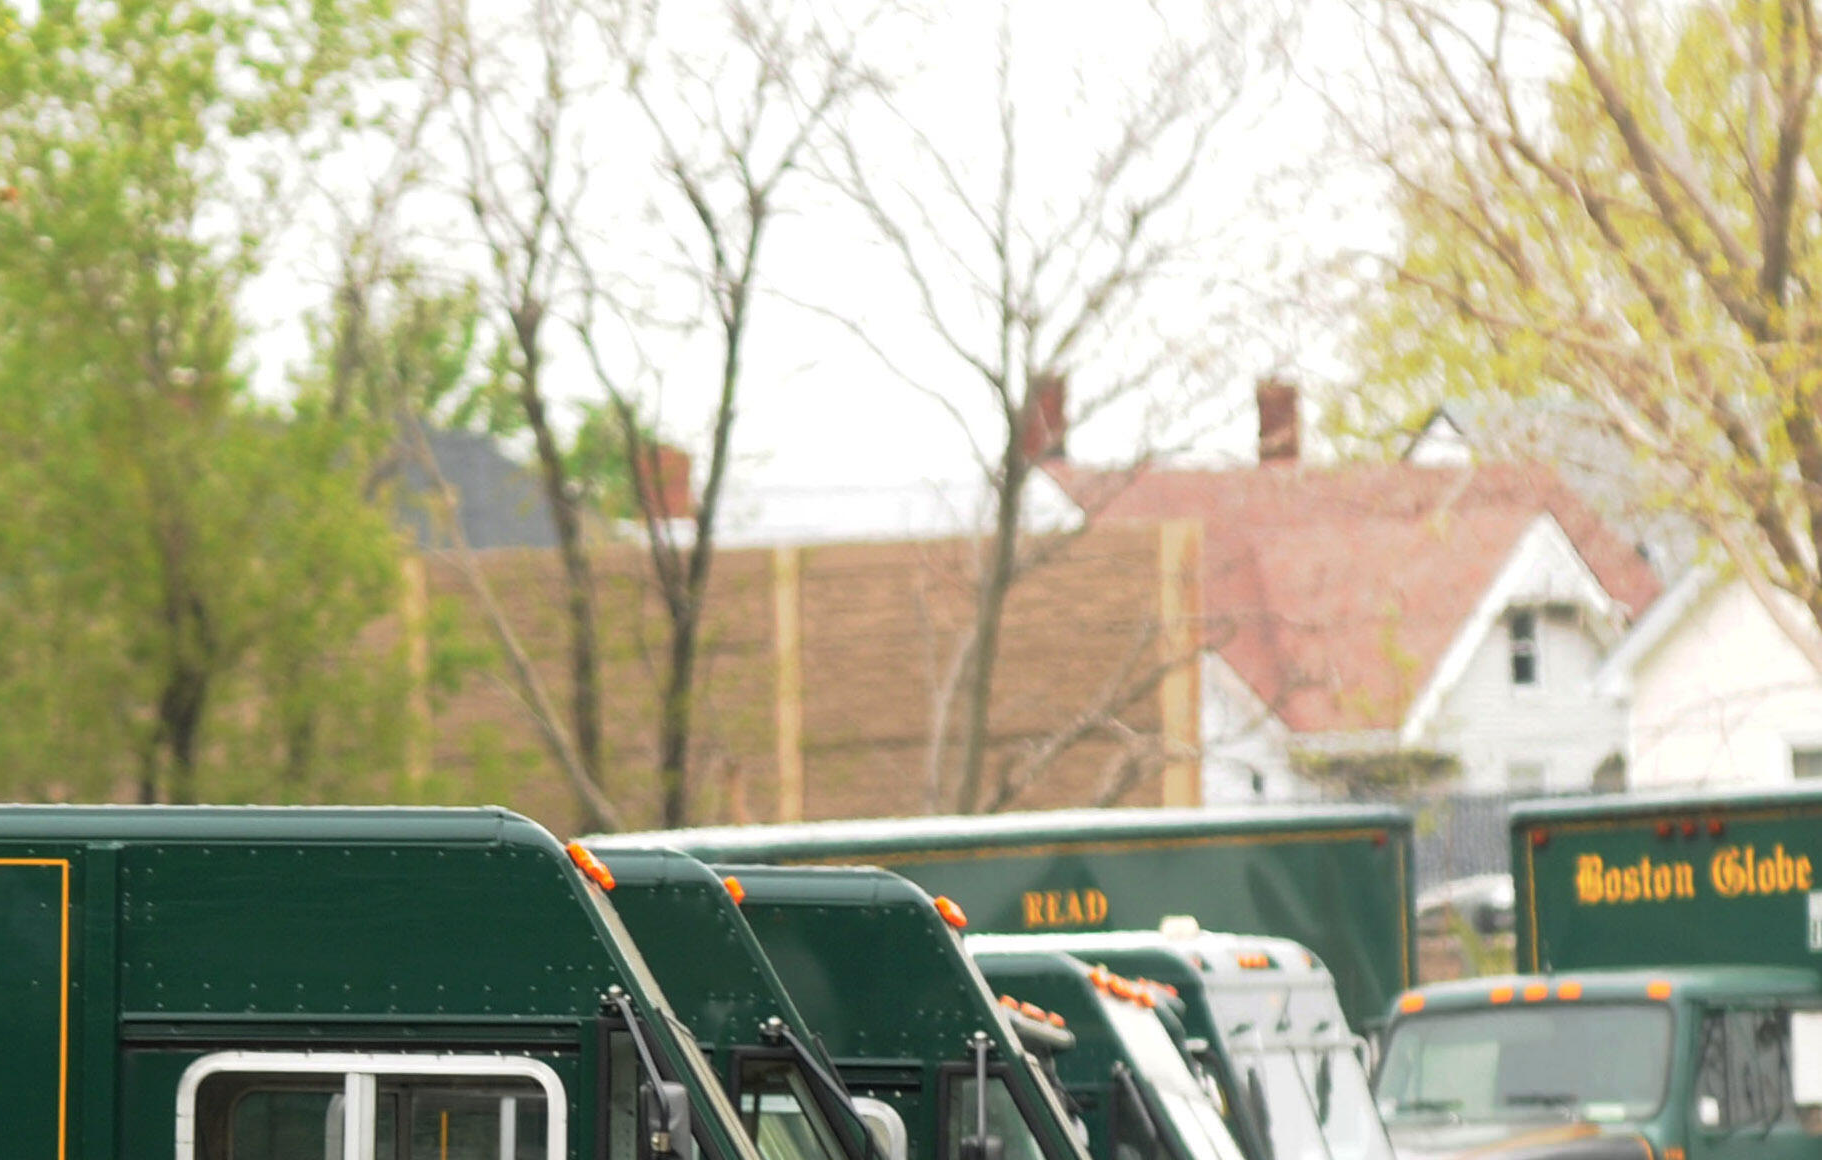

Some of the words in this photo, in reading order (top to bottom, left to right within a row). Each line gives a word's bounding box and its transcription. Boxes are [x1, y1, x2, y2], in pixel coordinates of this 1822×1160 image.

[1576, 853, 1696, 905] Boston
[1710, 843, 1813, 897] Globe
[1024, 889, 1109, 928] READ
